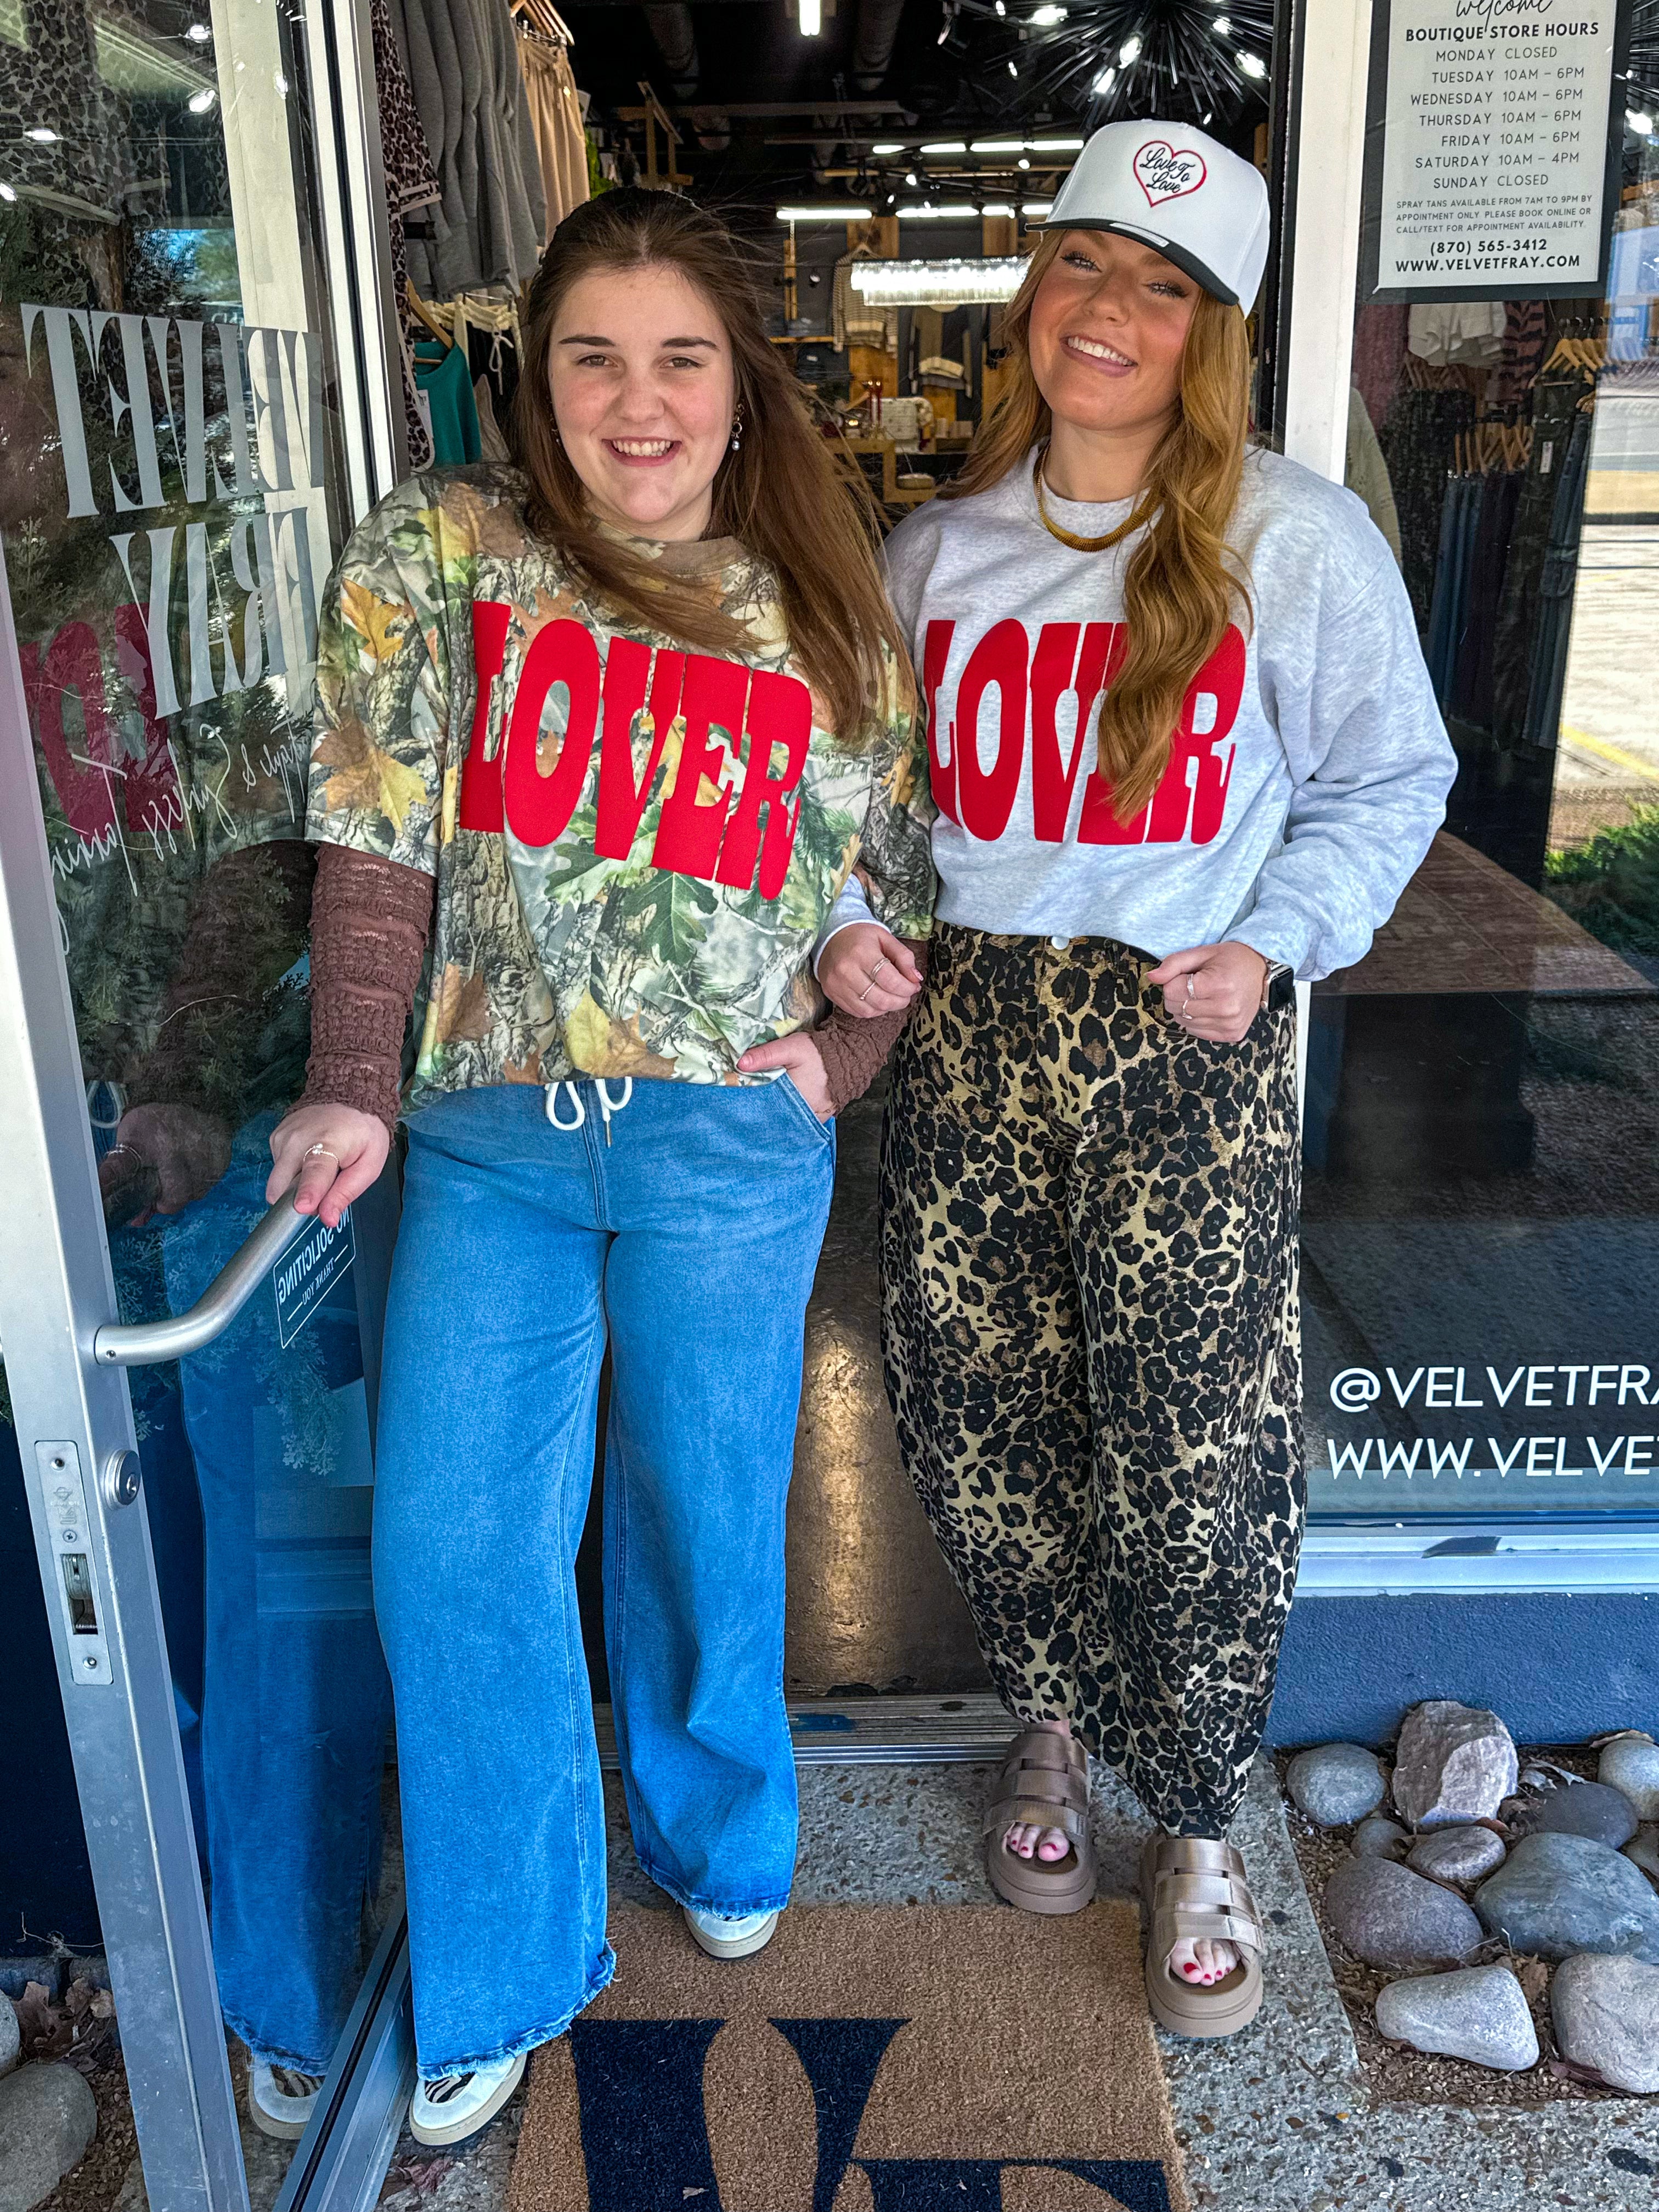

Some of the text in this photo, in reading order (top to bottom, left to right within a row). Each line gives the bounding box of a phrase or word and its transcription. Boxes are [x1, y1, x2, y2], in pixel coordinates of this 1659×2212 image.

[1406, 22, 1599, 42] BOUTIQUE STORE HOURS
[1436, 47, 1558, 61] MONDAY CLOSED
[1432, 70, 1493, 83] TUESDAY
[1504, 69, 1538, 81] 10AM
[1558, 67, 1584, 78] 6PM
[1411, 92, 1493, 105] WEDNESDAY
[1503, 90, 1537, 102] 10AM
[1556, 89, 1583, 100] 6PM
[1419, 113, 1491, 126] THURSDAY
[1502, 112, 1535, 123] 10AM
[1554, 110, 1581, 121] 6PM
[1442, 134, 1490, 147] FRIDAY
[1500, 133, 1534, 144] 10AM
[1553, 131, 1579, 142] 6PM
[1139, 148, 1178, 171] Love
[1415, 155, 1489, 168] SATURDAY
[1499, 154, 1532, 165] 10AM
[1552, 153, 1579, 163] 4PM
[1146, 171, 1181, 193] Love
[1434, 174, 1549, 189] SUNDAY CLOSED
[1397, 201, 1423, 209] SPRAY
[1485, 210, 1516, 218] PLEASE
[1519, 209, 1543, 217] BOOK
[1547, 208, 1576, 216] ONLINE
[1397, 225, 1443, 234] CALL/TEXT
[1467, 223, 1525, 232] APPOINTMENT
[1431, 239, 1547, 256] (870) 565-3412
[1396, 256, 1579, 272] WWW.VELVETFRAY.COM
[459, 600, 812, 901] LOVER
[1327, 1435, 1659, 1480] WWW.VELVE
